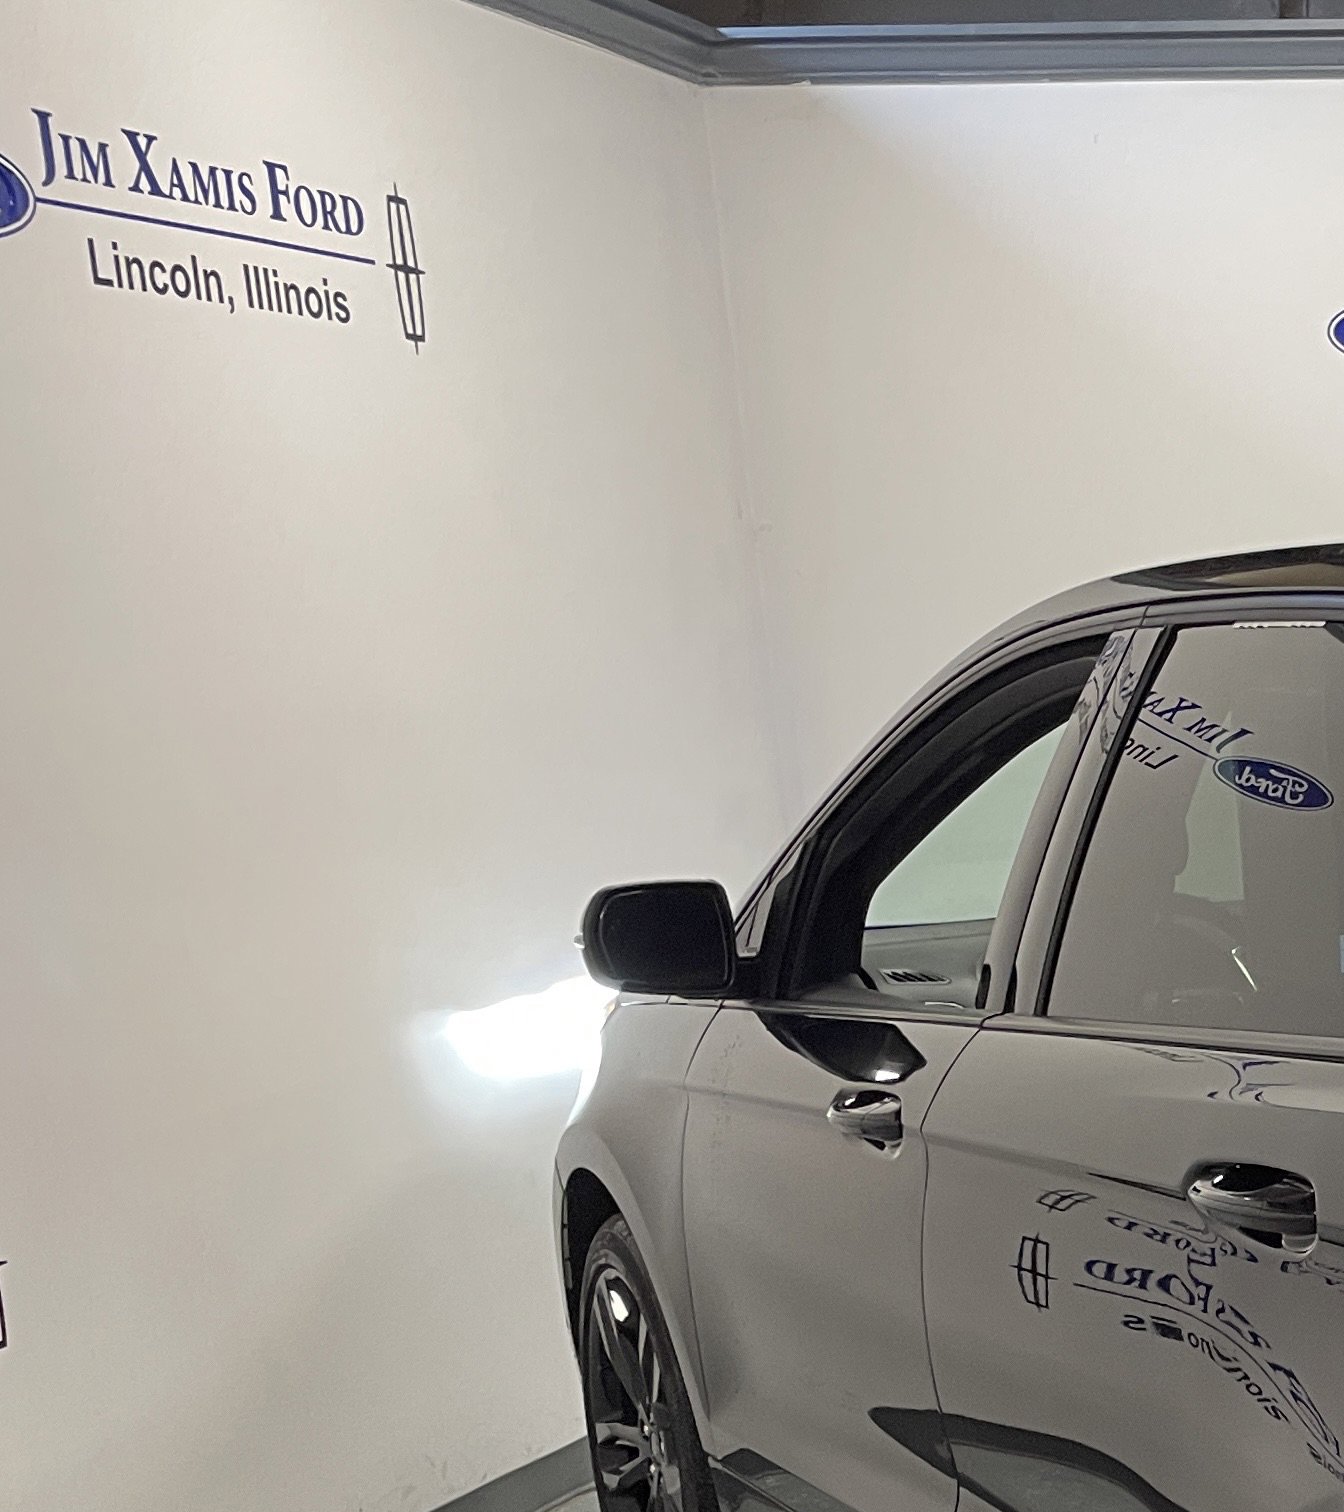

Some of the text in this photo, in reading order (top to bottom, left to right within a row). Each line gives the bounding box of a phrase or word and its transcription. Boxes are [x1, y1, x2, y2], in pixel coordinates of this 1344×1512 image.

[30, 107, 365, 237] JIM XAMIS FORD
[87, 237, 352, 324] Lincoln, Illinois
